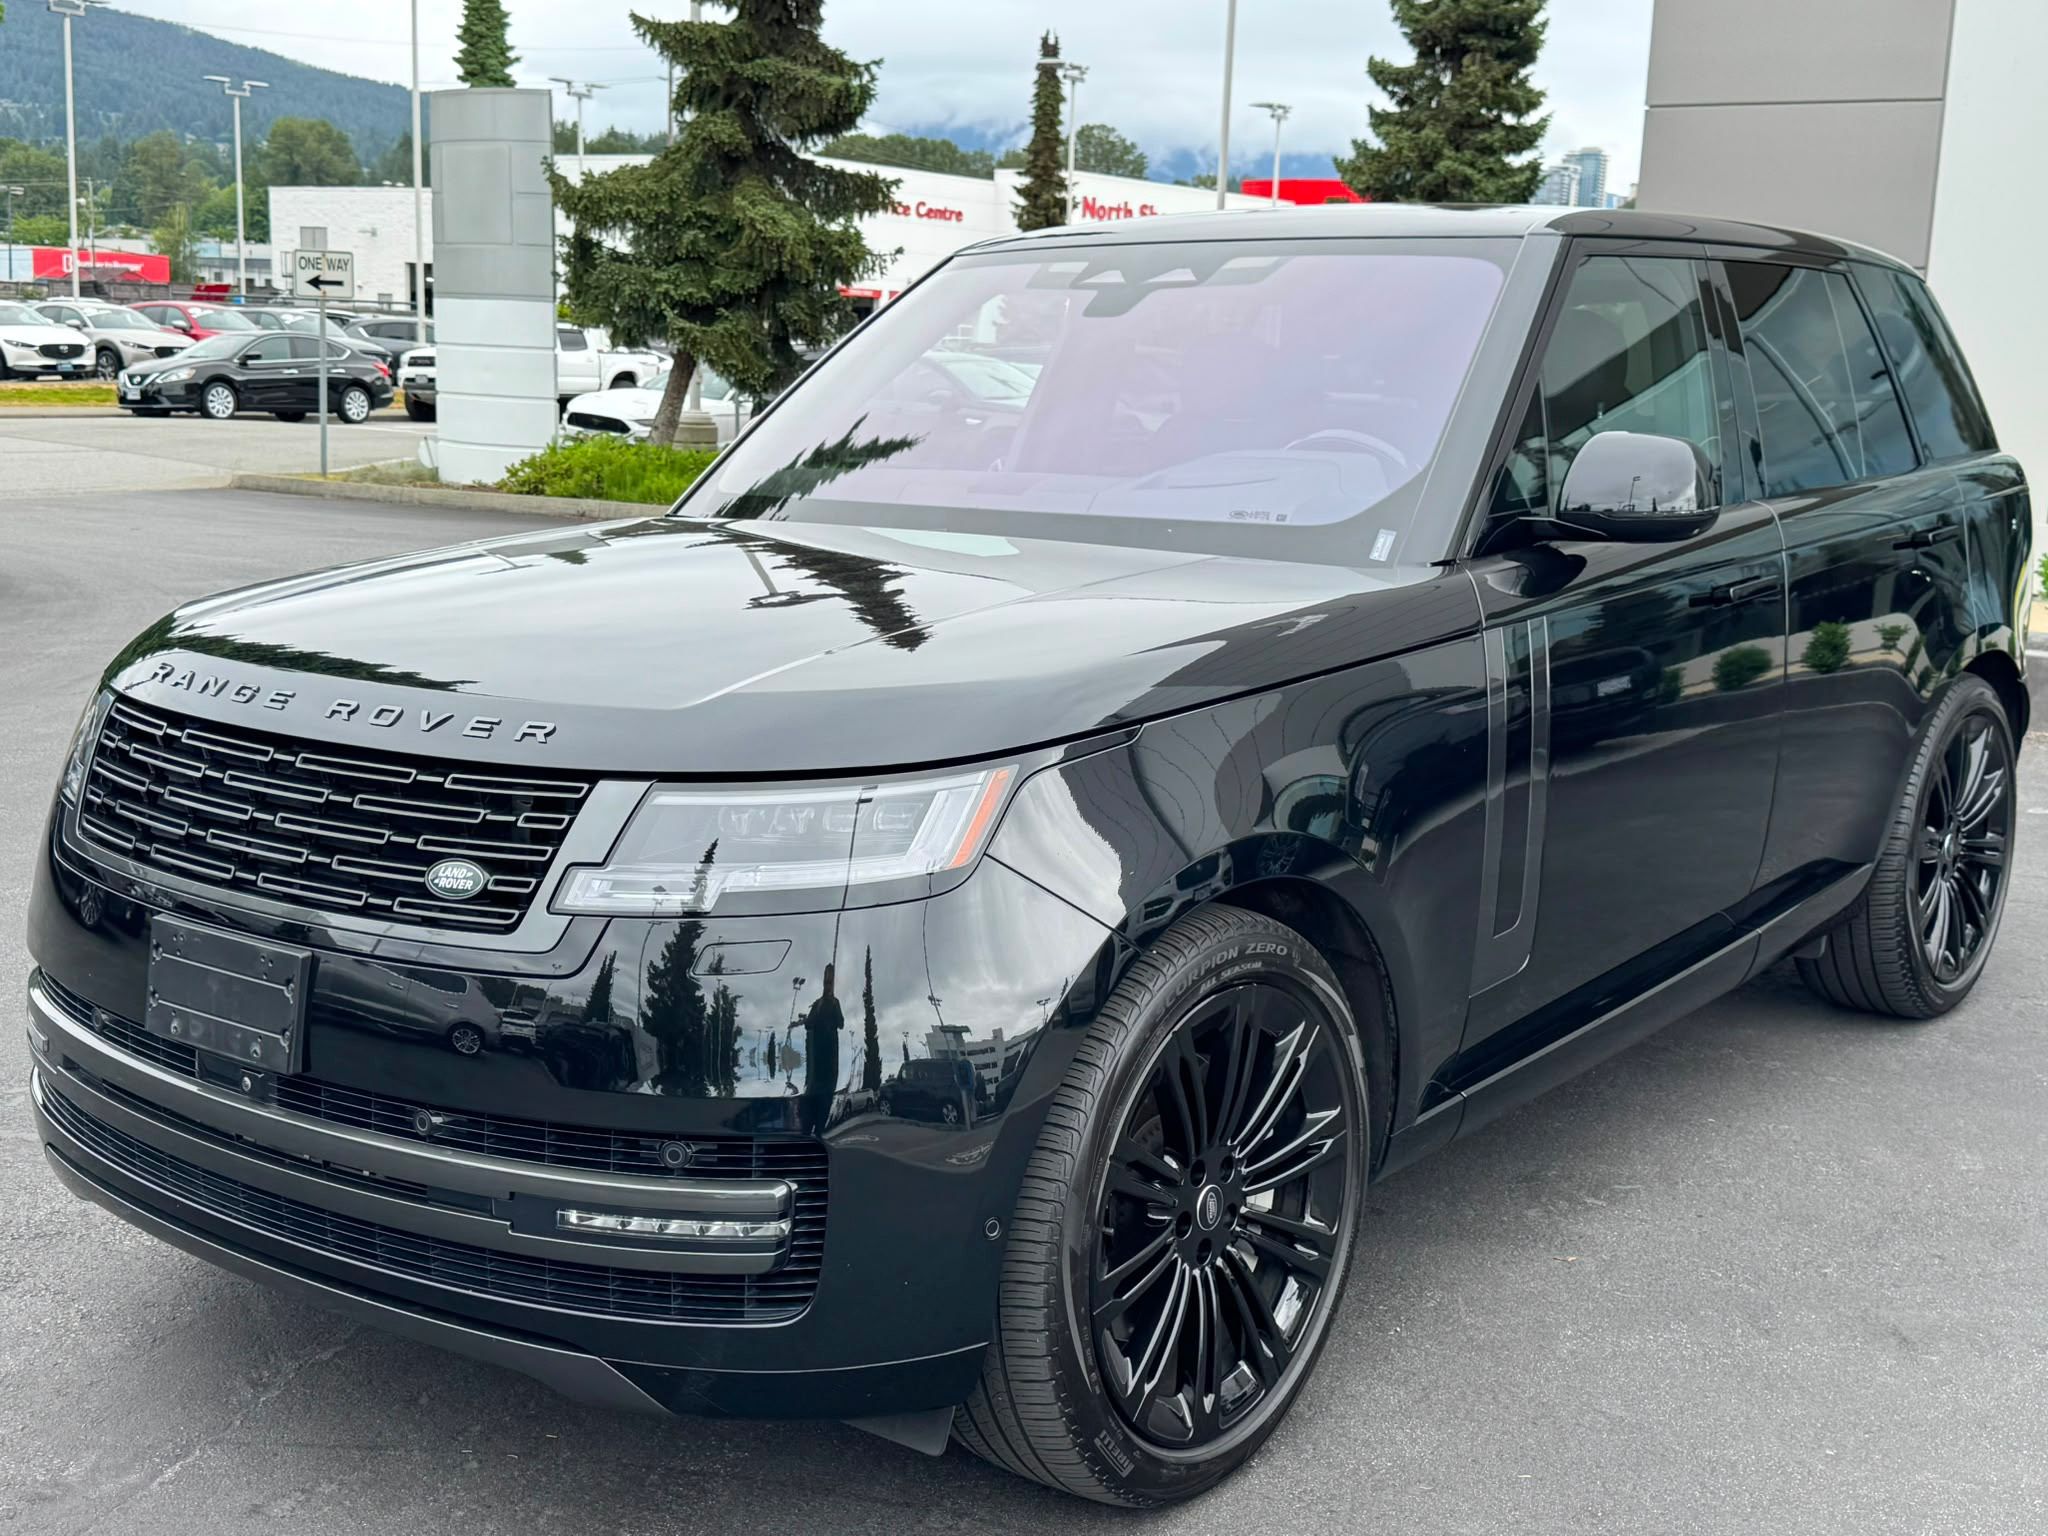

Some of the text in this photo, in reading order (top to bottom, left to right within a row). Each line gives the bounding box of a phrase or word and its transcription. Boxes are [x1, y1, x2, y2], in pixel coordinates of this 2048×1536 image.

[915, 201, 963, 222] Centre
[1081, 196, 1133, 221] North
[298, 256, 350, 272] ONE WAY
[150, 662, 558, 745] RANGE ROVER
[438, 866, 468, 879] LAND
[437, 877, 474, 891] ROVER
[1245, 942, 1288, 956] ZERO
[1200, 978, 1218, 994] ALL
